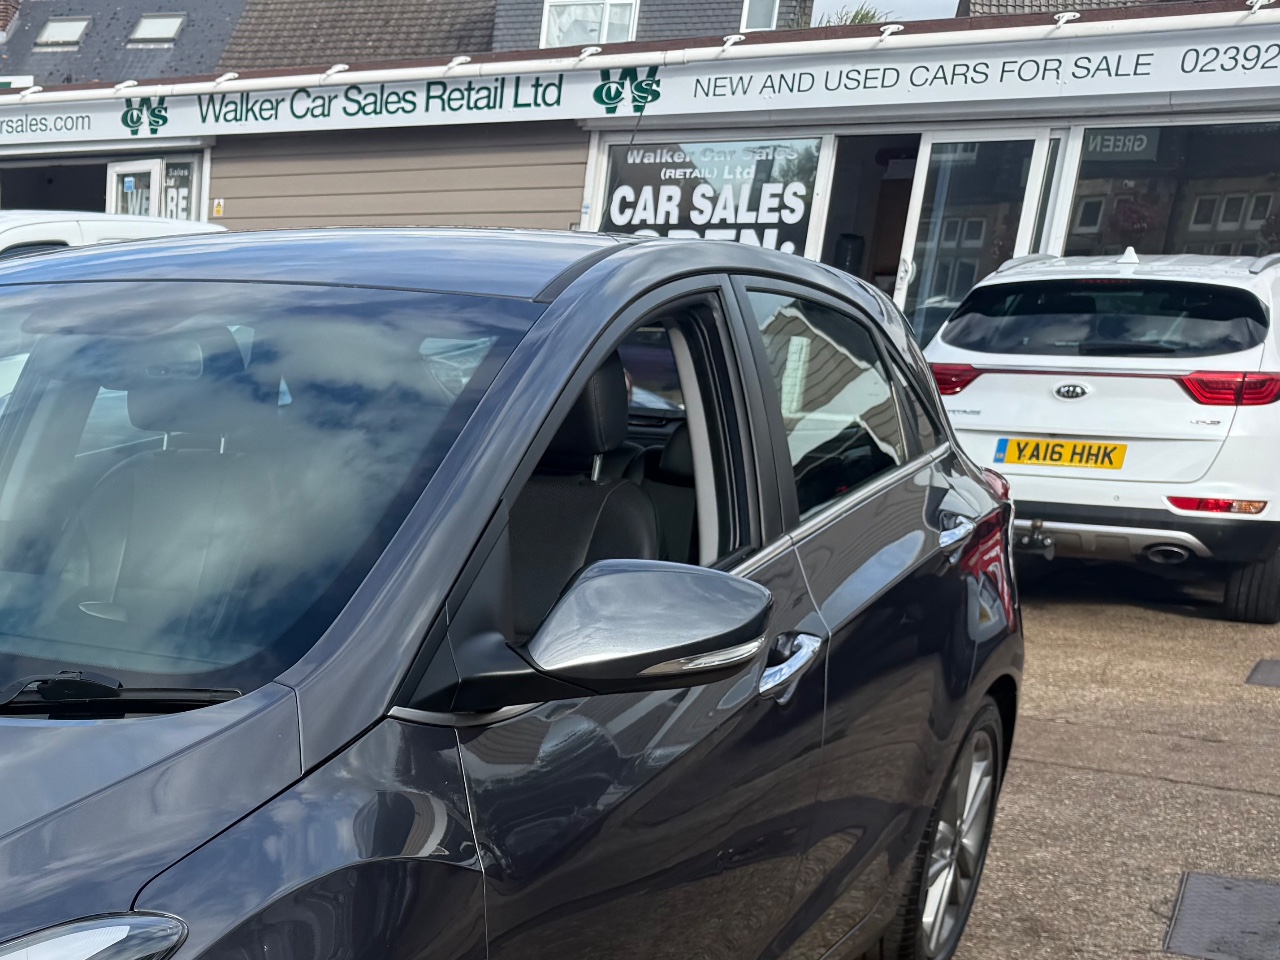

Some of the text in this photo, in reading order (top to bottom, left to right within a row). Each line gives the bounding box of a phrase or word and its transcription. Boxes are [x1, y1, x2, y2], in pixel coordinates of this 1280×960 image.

[1180, 43, 1280, 73] 02392
[694, 53, 1155, 99] NEW AND USED CARS FOR SALE
[198, 73, 564, 124] Walker Car Sales Retail Ltd
[627, 149, 694, 164] Walker
[660, 165, 756, 180] (RETAIL) Ltd
[609, 181, 807, 225] CAR SALES
[1016, 441, 1064, 461] YA16
[1070, 444, 1118, 466] HHK
